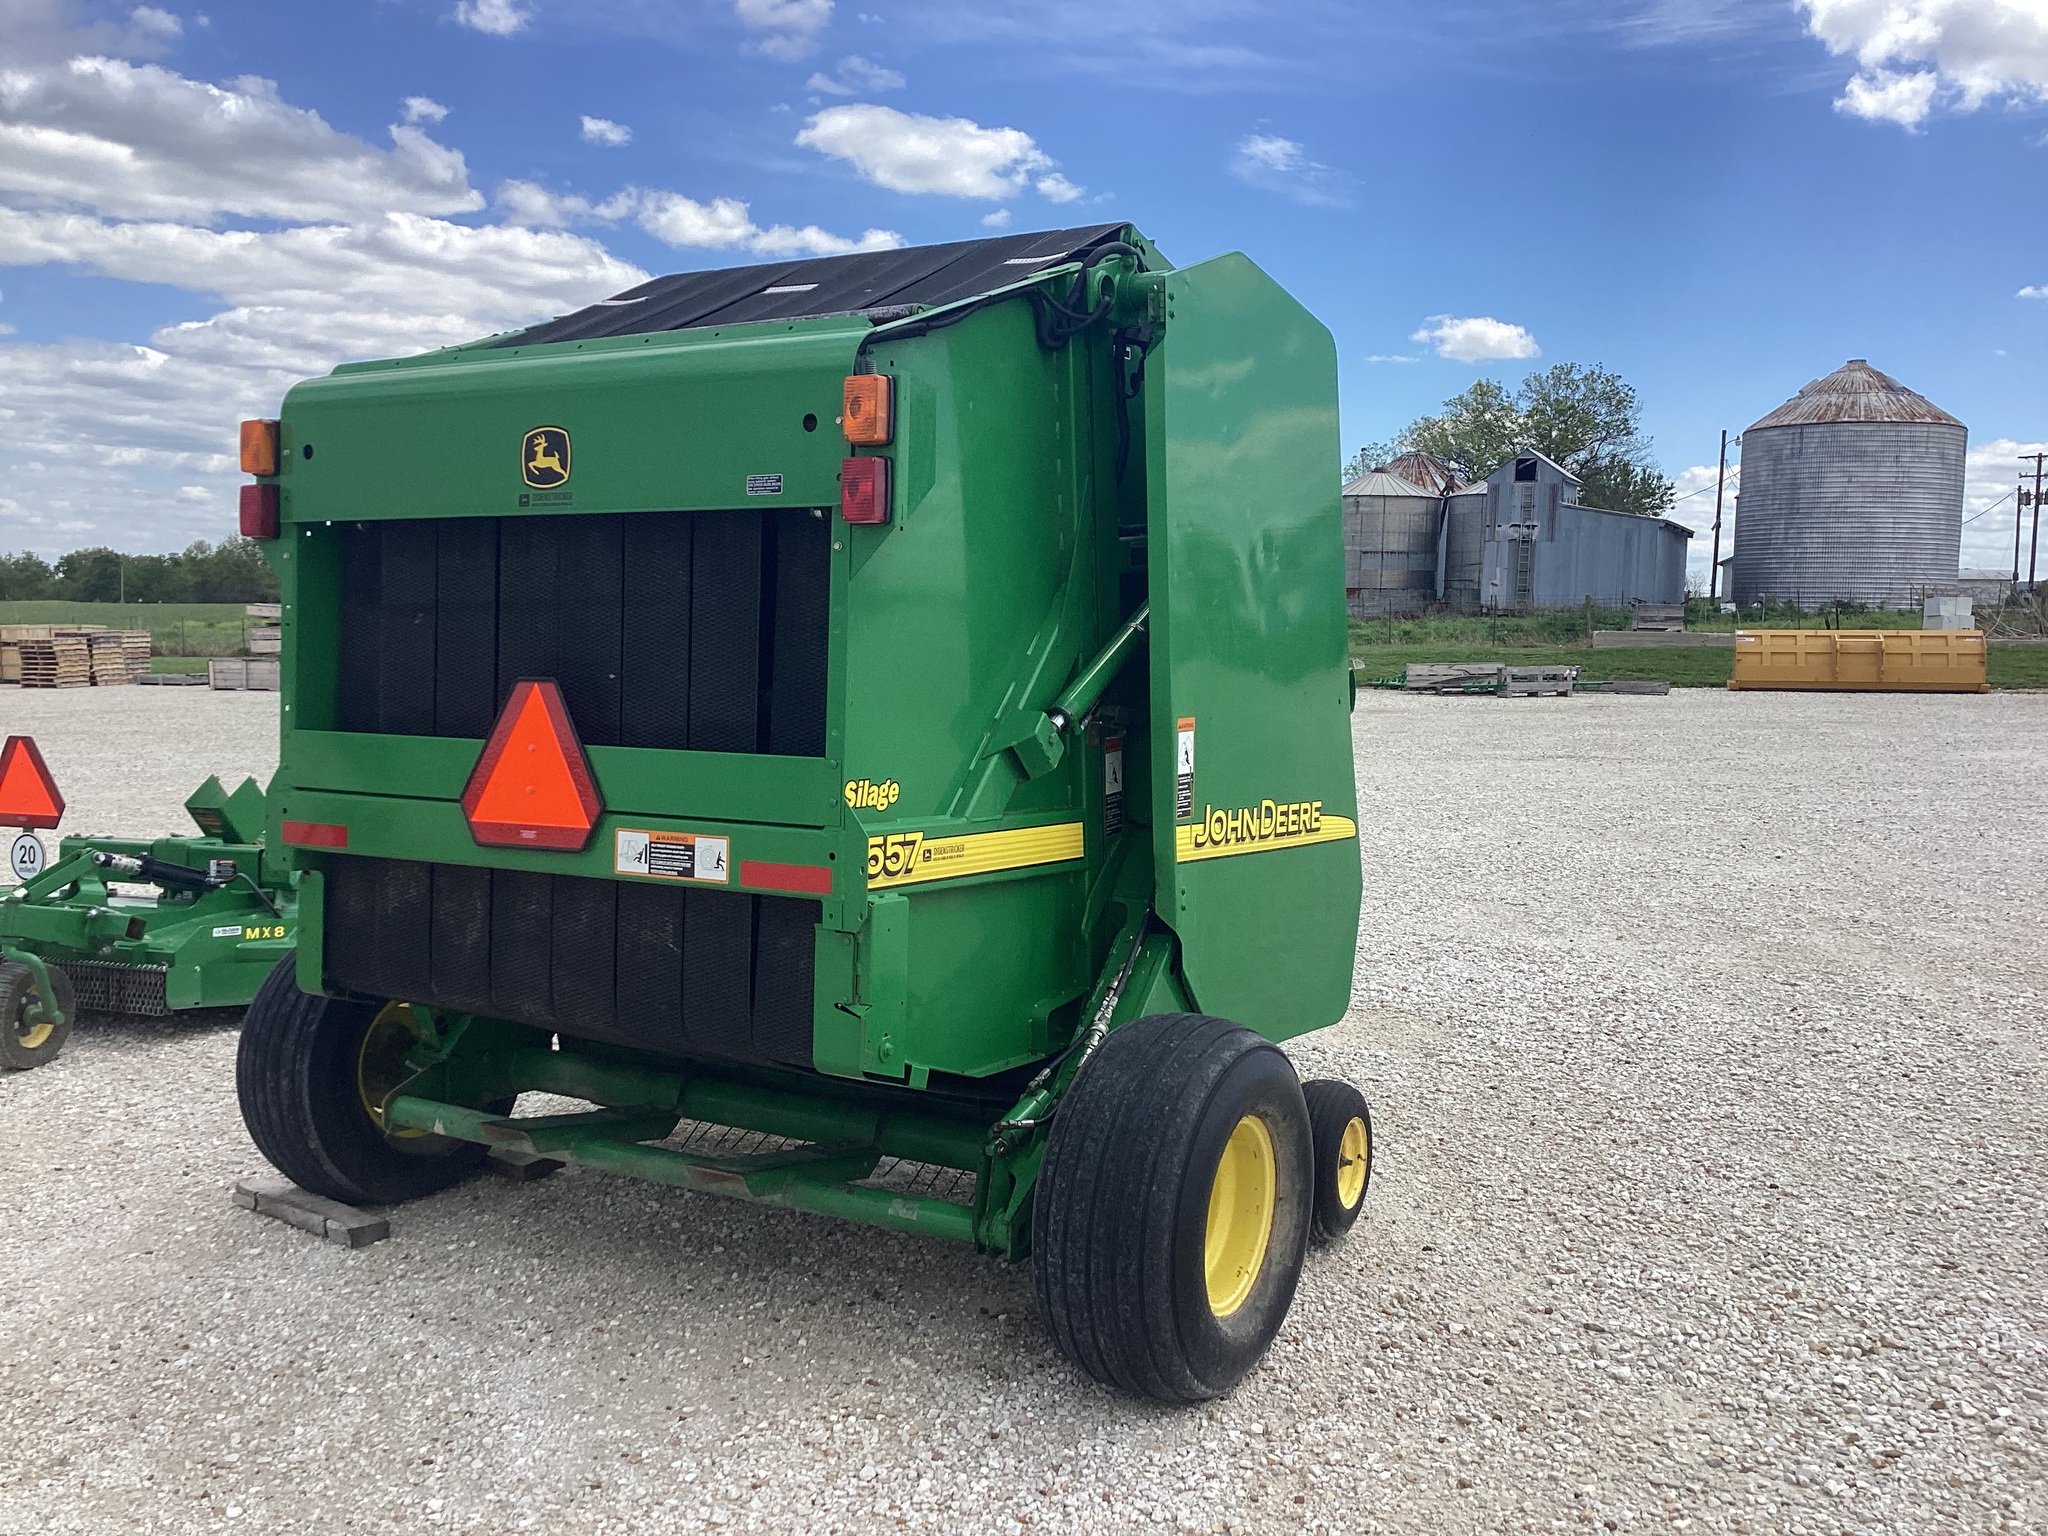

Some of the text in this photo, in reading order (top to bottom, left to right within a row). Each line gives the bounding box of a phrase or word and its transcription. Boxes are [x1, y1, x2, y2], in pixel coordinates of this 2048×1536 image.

[844, 778, 900, 812] Silage
[661, 835, 689, 843] WARNING
[1195, 799, 1322, 847] JOHN DEERE
[19, 844, 36, 865] 20
[868, 831, 924, 879] 557
